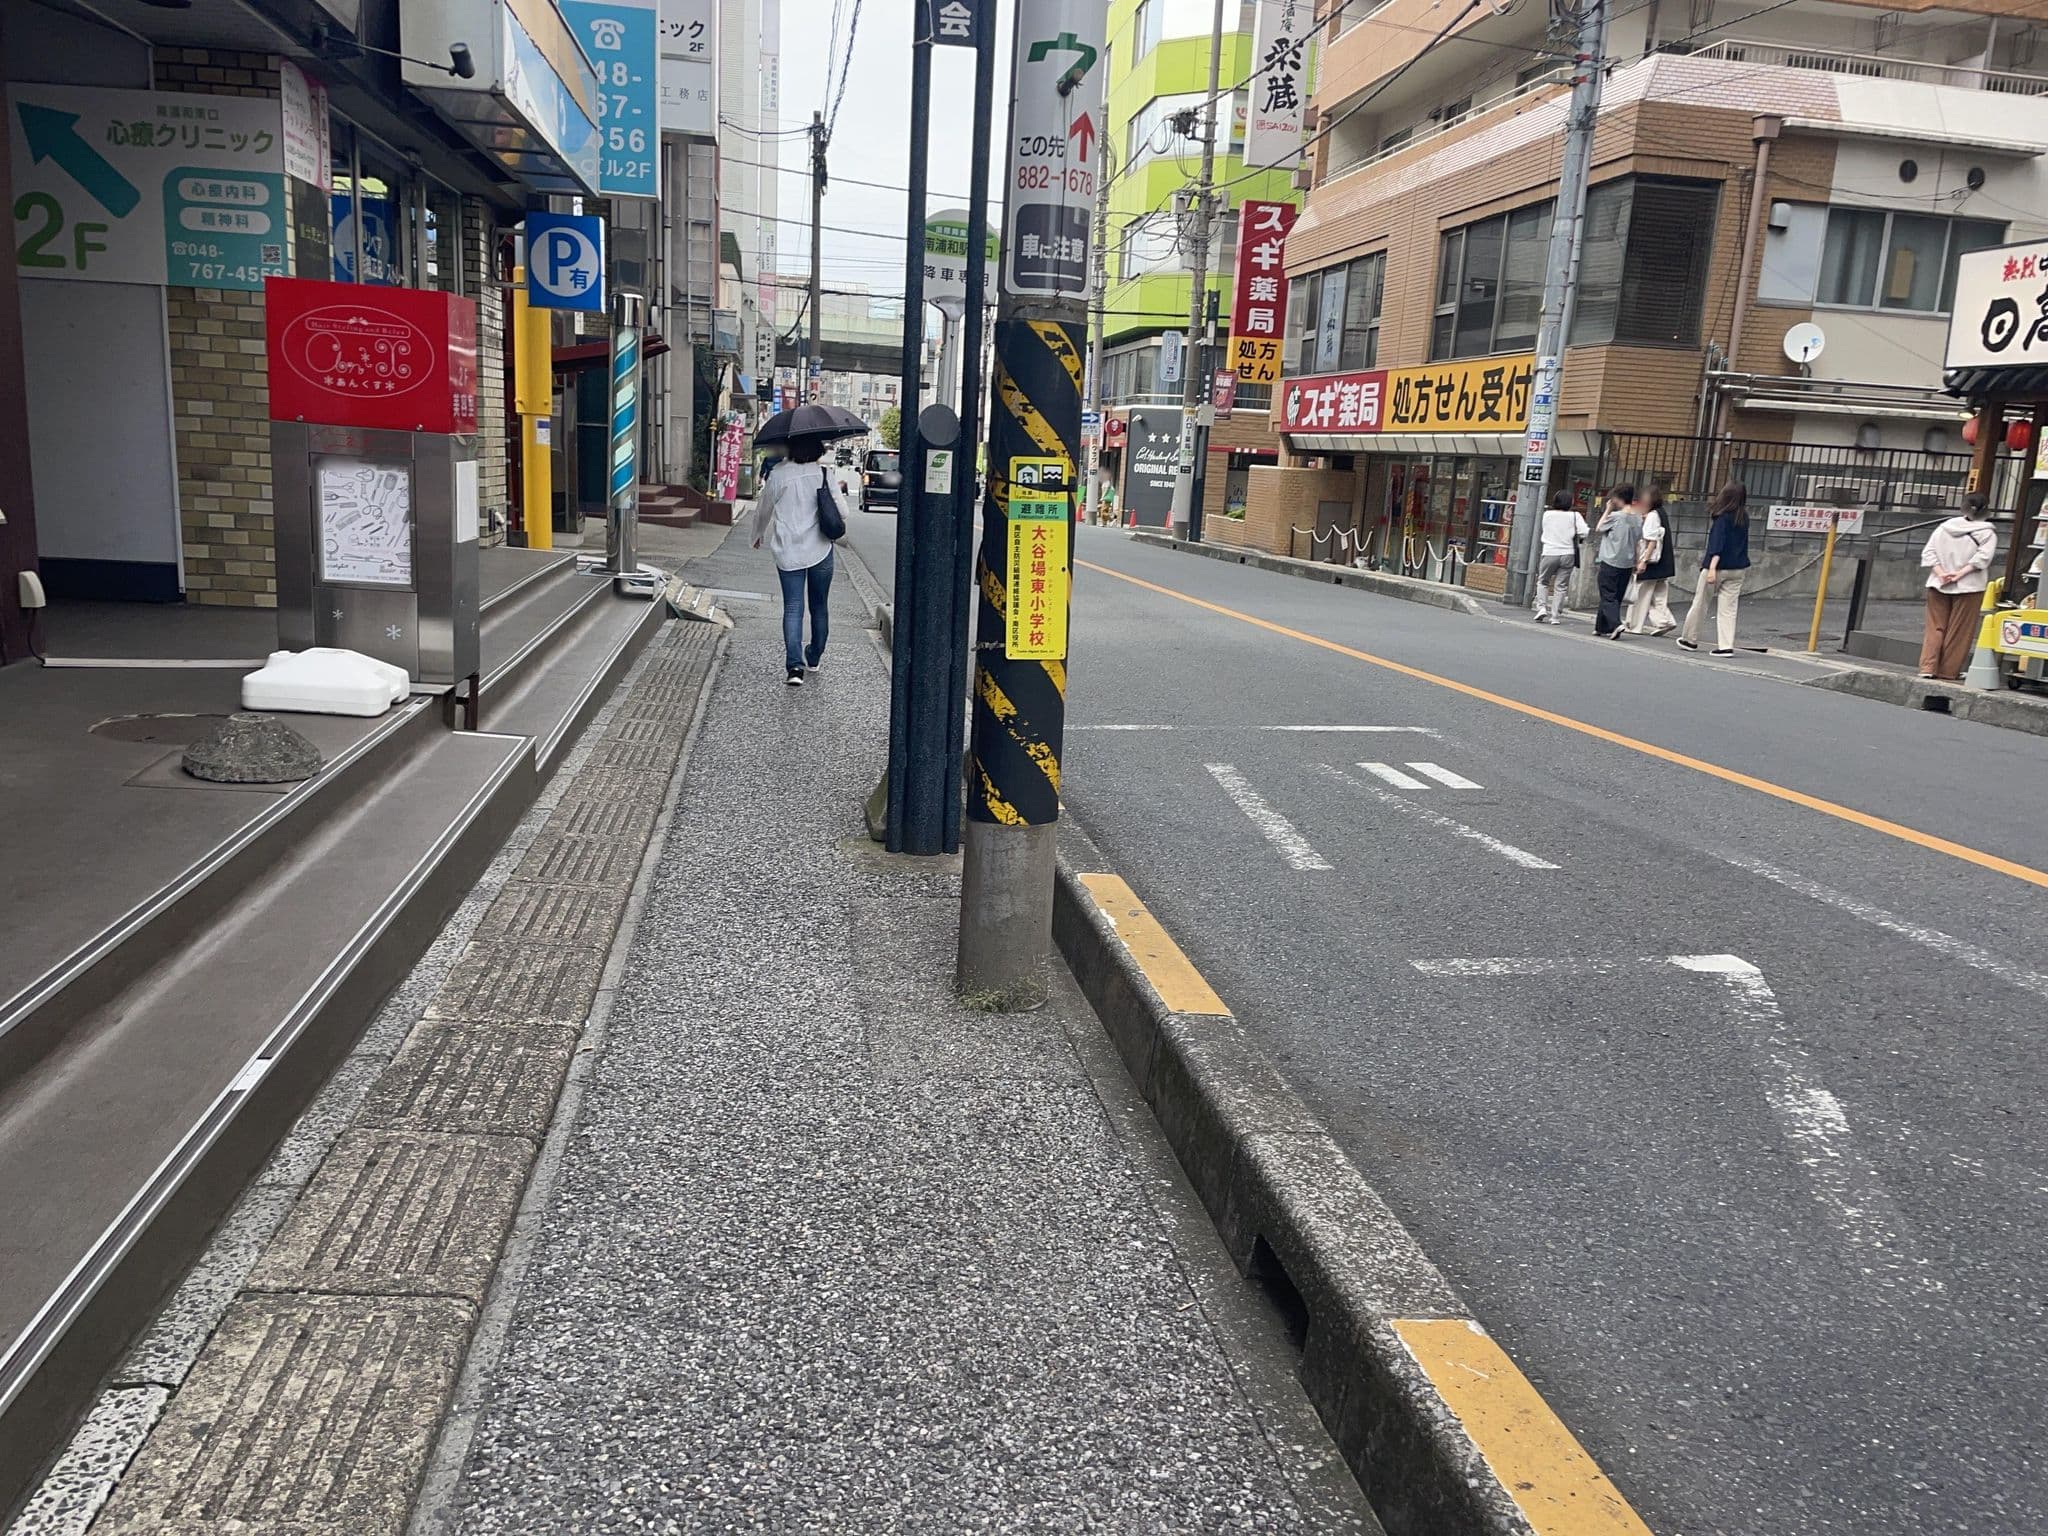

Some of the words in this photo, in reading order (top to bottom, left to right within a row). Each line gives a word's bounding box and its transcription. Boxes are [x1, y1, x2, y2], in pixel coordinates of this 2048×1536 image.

[938, 0, 971, 37] 会
[688, 42, 705, 53] 2F
[594, 60, 642, 87] 48-
[593, 95, 642, 119] 67-
[106, 118, 275, 155] 心療クリニック
[1018, 135, 1065, 158] この先
[190, 182, 257, 201] 心療内科
[1017, 165, 1093, 196] 882-1678
[13, 191, 109, 271] 2F
[548, 232, 582, 286] P
[925, 237, 993, 259] 南浦和駅口
[1020, 233, 1086, 264] 車に注意
[568, 268, 590, 290] 有
[1245, 205, 1285, 334] スギ薬局
[1238, 340, 1278, 360] 処方
[1238, 361, 1275, 382] せん
[336, 377, 382, 391] あんくす
[1391, 360, 1534, 425] 処方せん受付
[1302, 380, 1380, 428] スギ薬局
[1134, 463, 1168, 475] ORIGINAL
[1020, 503, 1058, 515] 避難所
[1774, 508, 1858, 520] ここは日高屋の輪場
[1028, 524, 1047, 646] 大谷場東小学校
